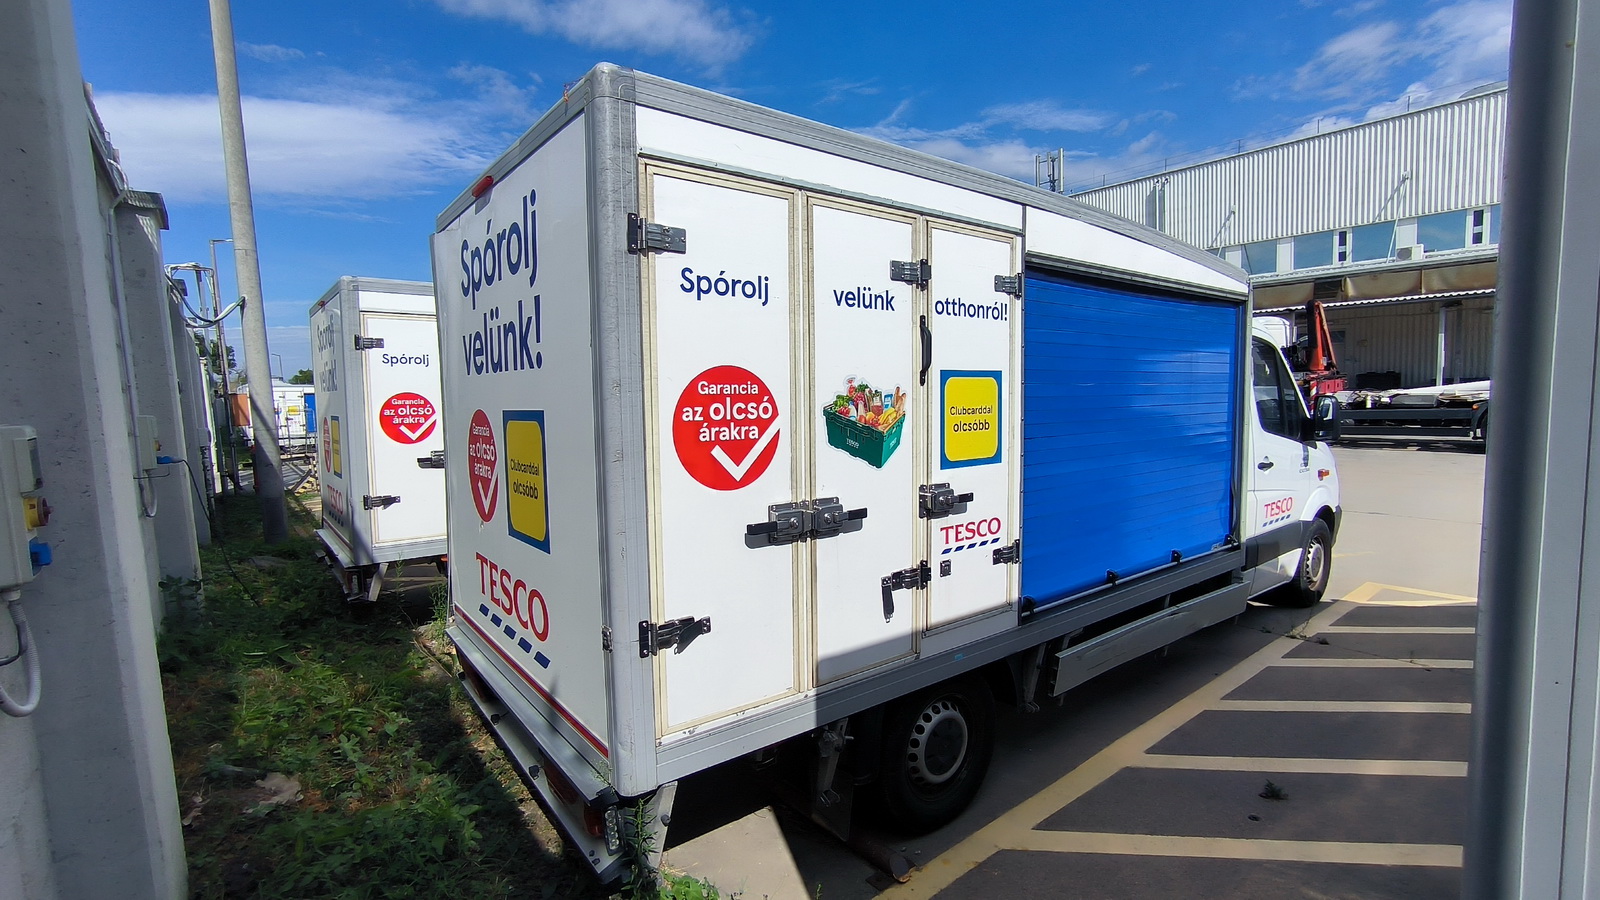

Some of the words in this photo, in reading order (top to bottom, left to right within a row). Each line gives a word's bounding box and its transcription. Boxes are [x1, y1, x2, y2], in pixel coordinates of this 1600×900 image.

[460, 188, 538, 310] Spórolj
[680, 267, 769, 306] Spórolj
[833, 286, 895, 311] velünk
[934, 297, 1008, 321] otthonról!
[462, 294, 543, 376] velünk!
[382, 353, 430, 367] Spórolj
[697, 381, 758, 395] Garancia
[384, 408, 395, 416] az
[398, 404, 432, 415] olcsó
[682, 406, 704, 421] az
[709, 396, 773, 420] olcsó
[949, 405, 993, 416] Clubcarddal
[392, 414, 425, 424] árakra
[953, 419, 990, 432] olcsóbb
[472, 422, 490, 437] Garancia
[699, 422, 759, 441] árakra
[469, 443, 476, 456] az
[476, 435, 495, 461] olcsó
[474, 459, 492, 479] árakra
[510, 458, 540, 476] Clubcarddal
[513, 480, 539, 500] olcsóbb
[1264, 496, 1293, 519] TESCO
[940, 517, 1002, 544] TESCO
[475, 551, 550, 642] TESCO
